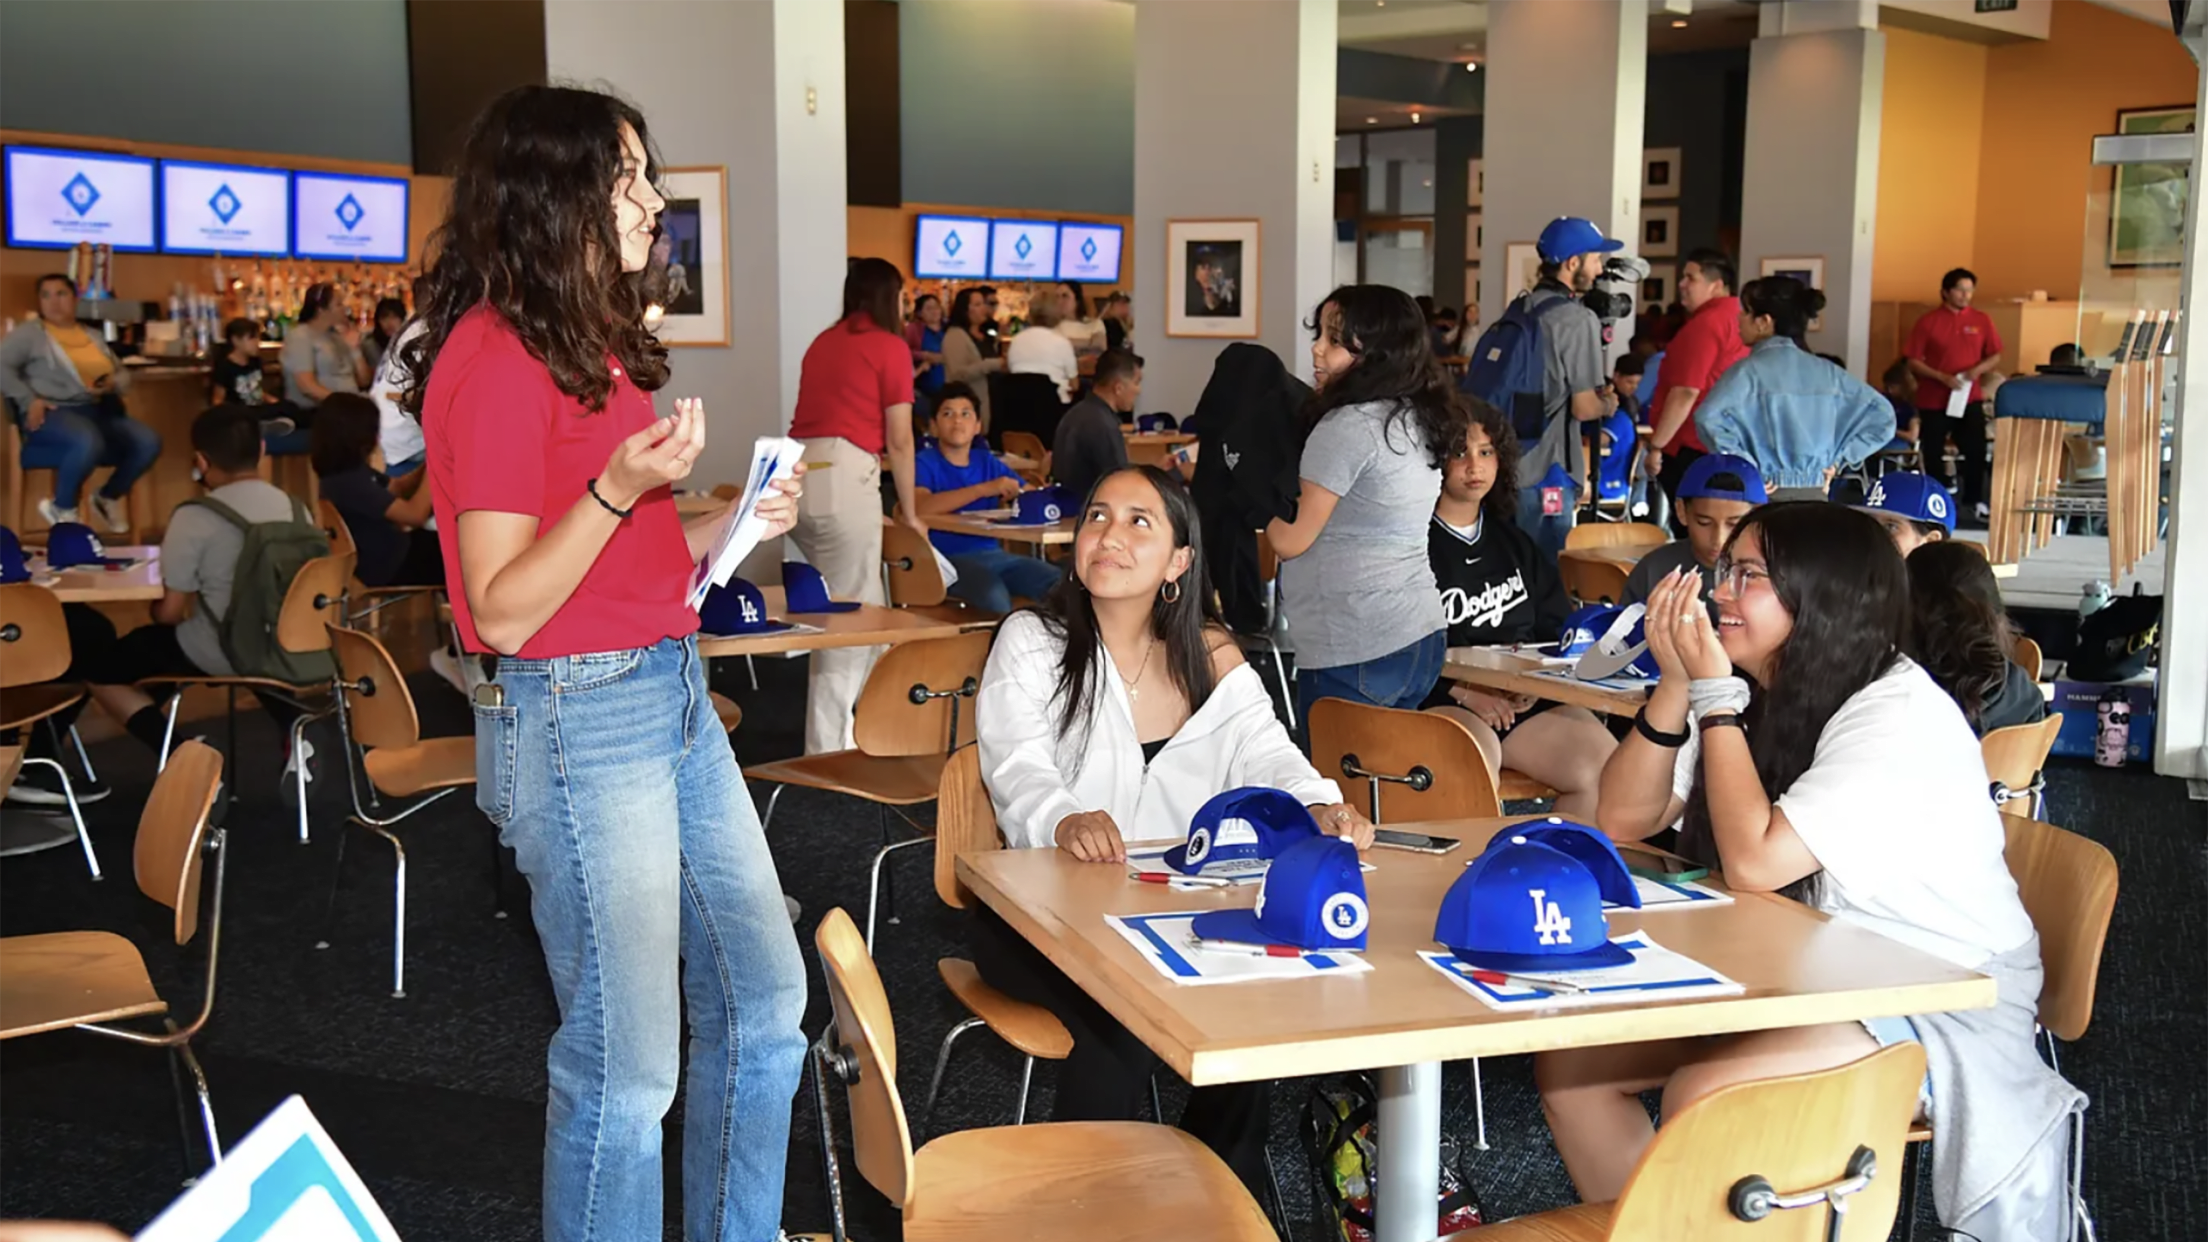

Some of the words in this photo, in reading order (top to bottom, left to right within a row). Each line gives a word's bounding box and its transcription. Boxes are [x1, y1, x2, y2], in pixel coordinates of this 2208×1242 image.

[1866, 480, 1887, 507] LA
[737, 594, 760, 623] LA
[1440, 568, 1528, 628] Dodgers
[1337, 905, 1352, 926] LA
[1529, 889, 1573, 945] LA
